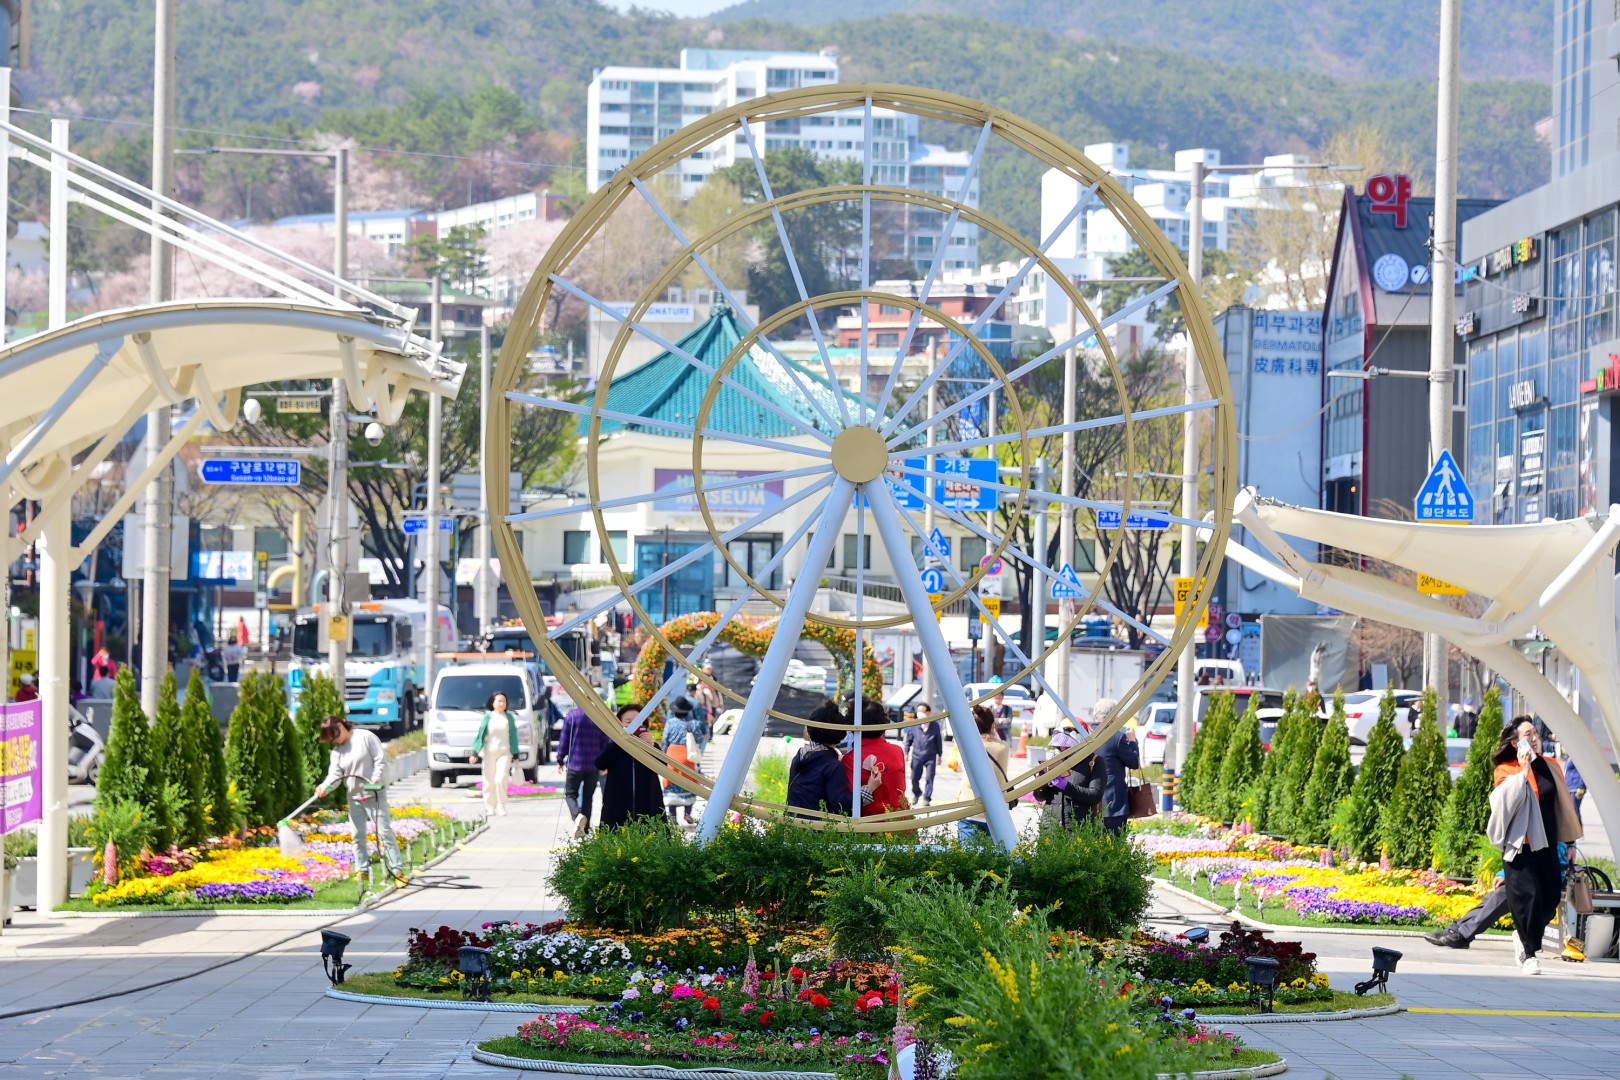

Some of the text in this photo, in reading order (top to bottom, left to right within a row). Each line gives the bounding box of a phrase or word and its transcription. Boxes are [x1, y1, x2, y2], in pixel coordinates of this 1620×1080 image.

[1366, 174, 1412, 229] 약
[944, 460, 971, 472] 기장
[1422, 507, 1470, 518] 횡단보도
